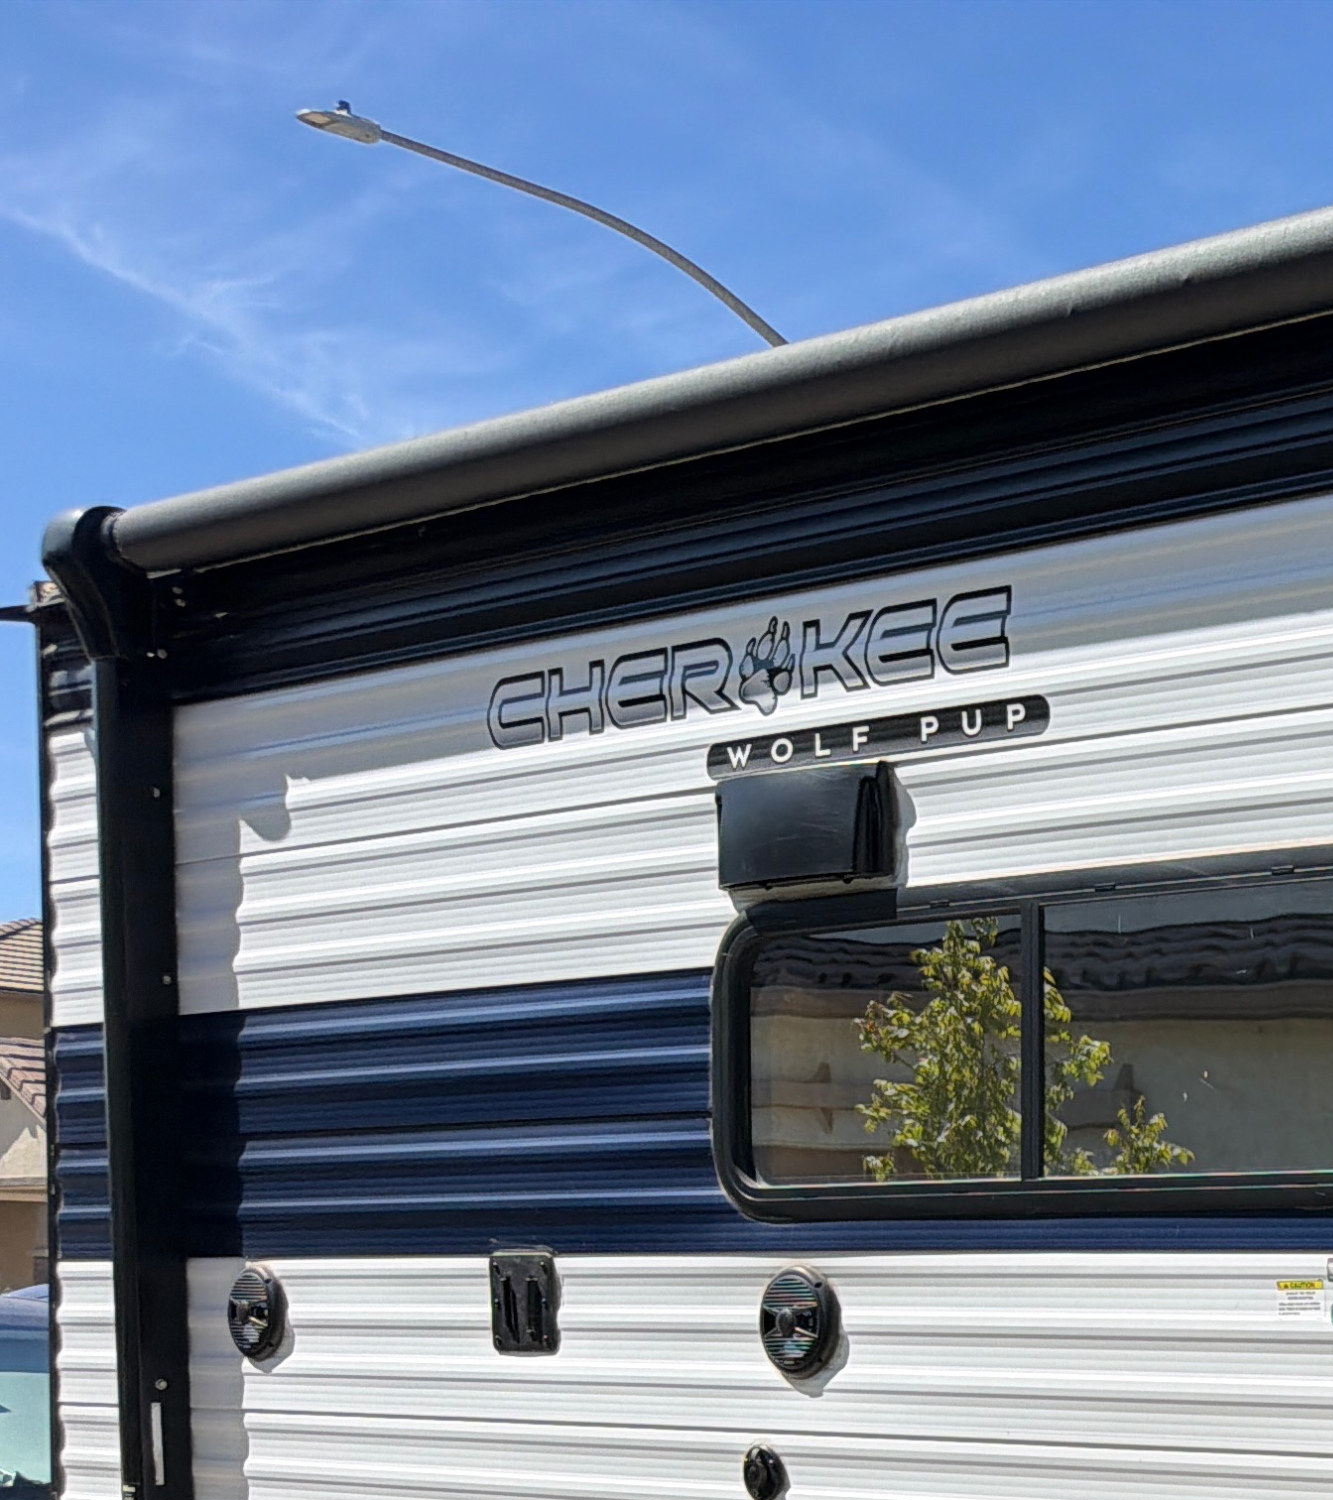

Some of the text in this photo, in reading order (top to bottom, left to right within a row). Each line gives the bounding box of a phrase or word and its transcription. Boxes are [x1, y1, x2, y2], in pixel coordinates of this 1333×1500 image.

[487, 585, 1013, 750] CHERKEE
[726, 702, 1027, 770] WOLF PUP
